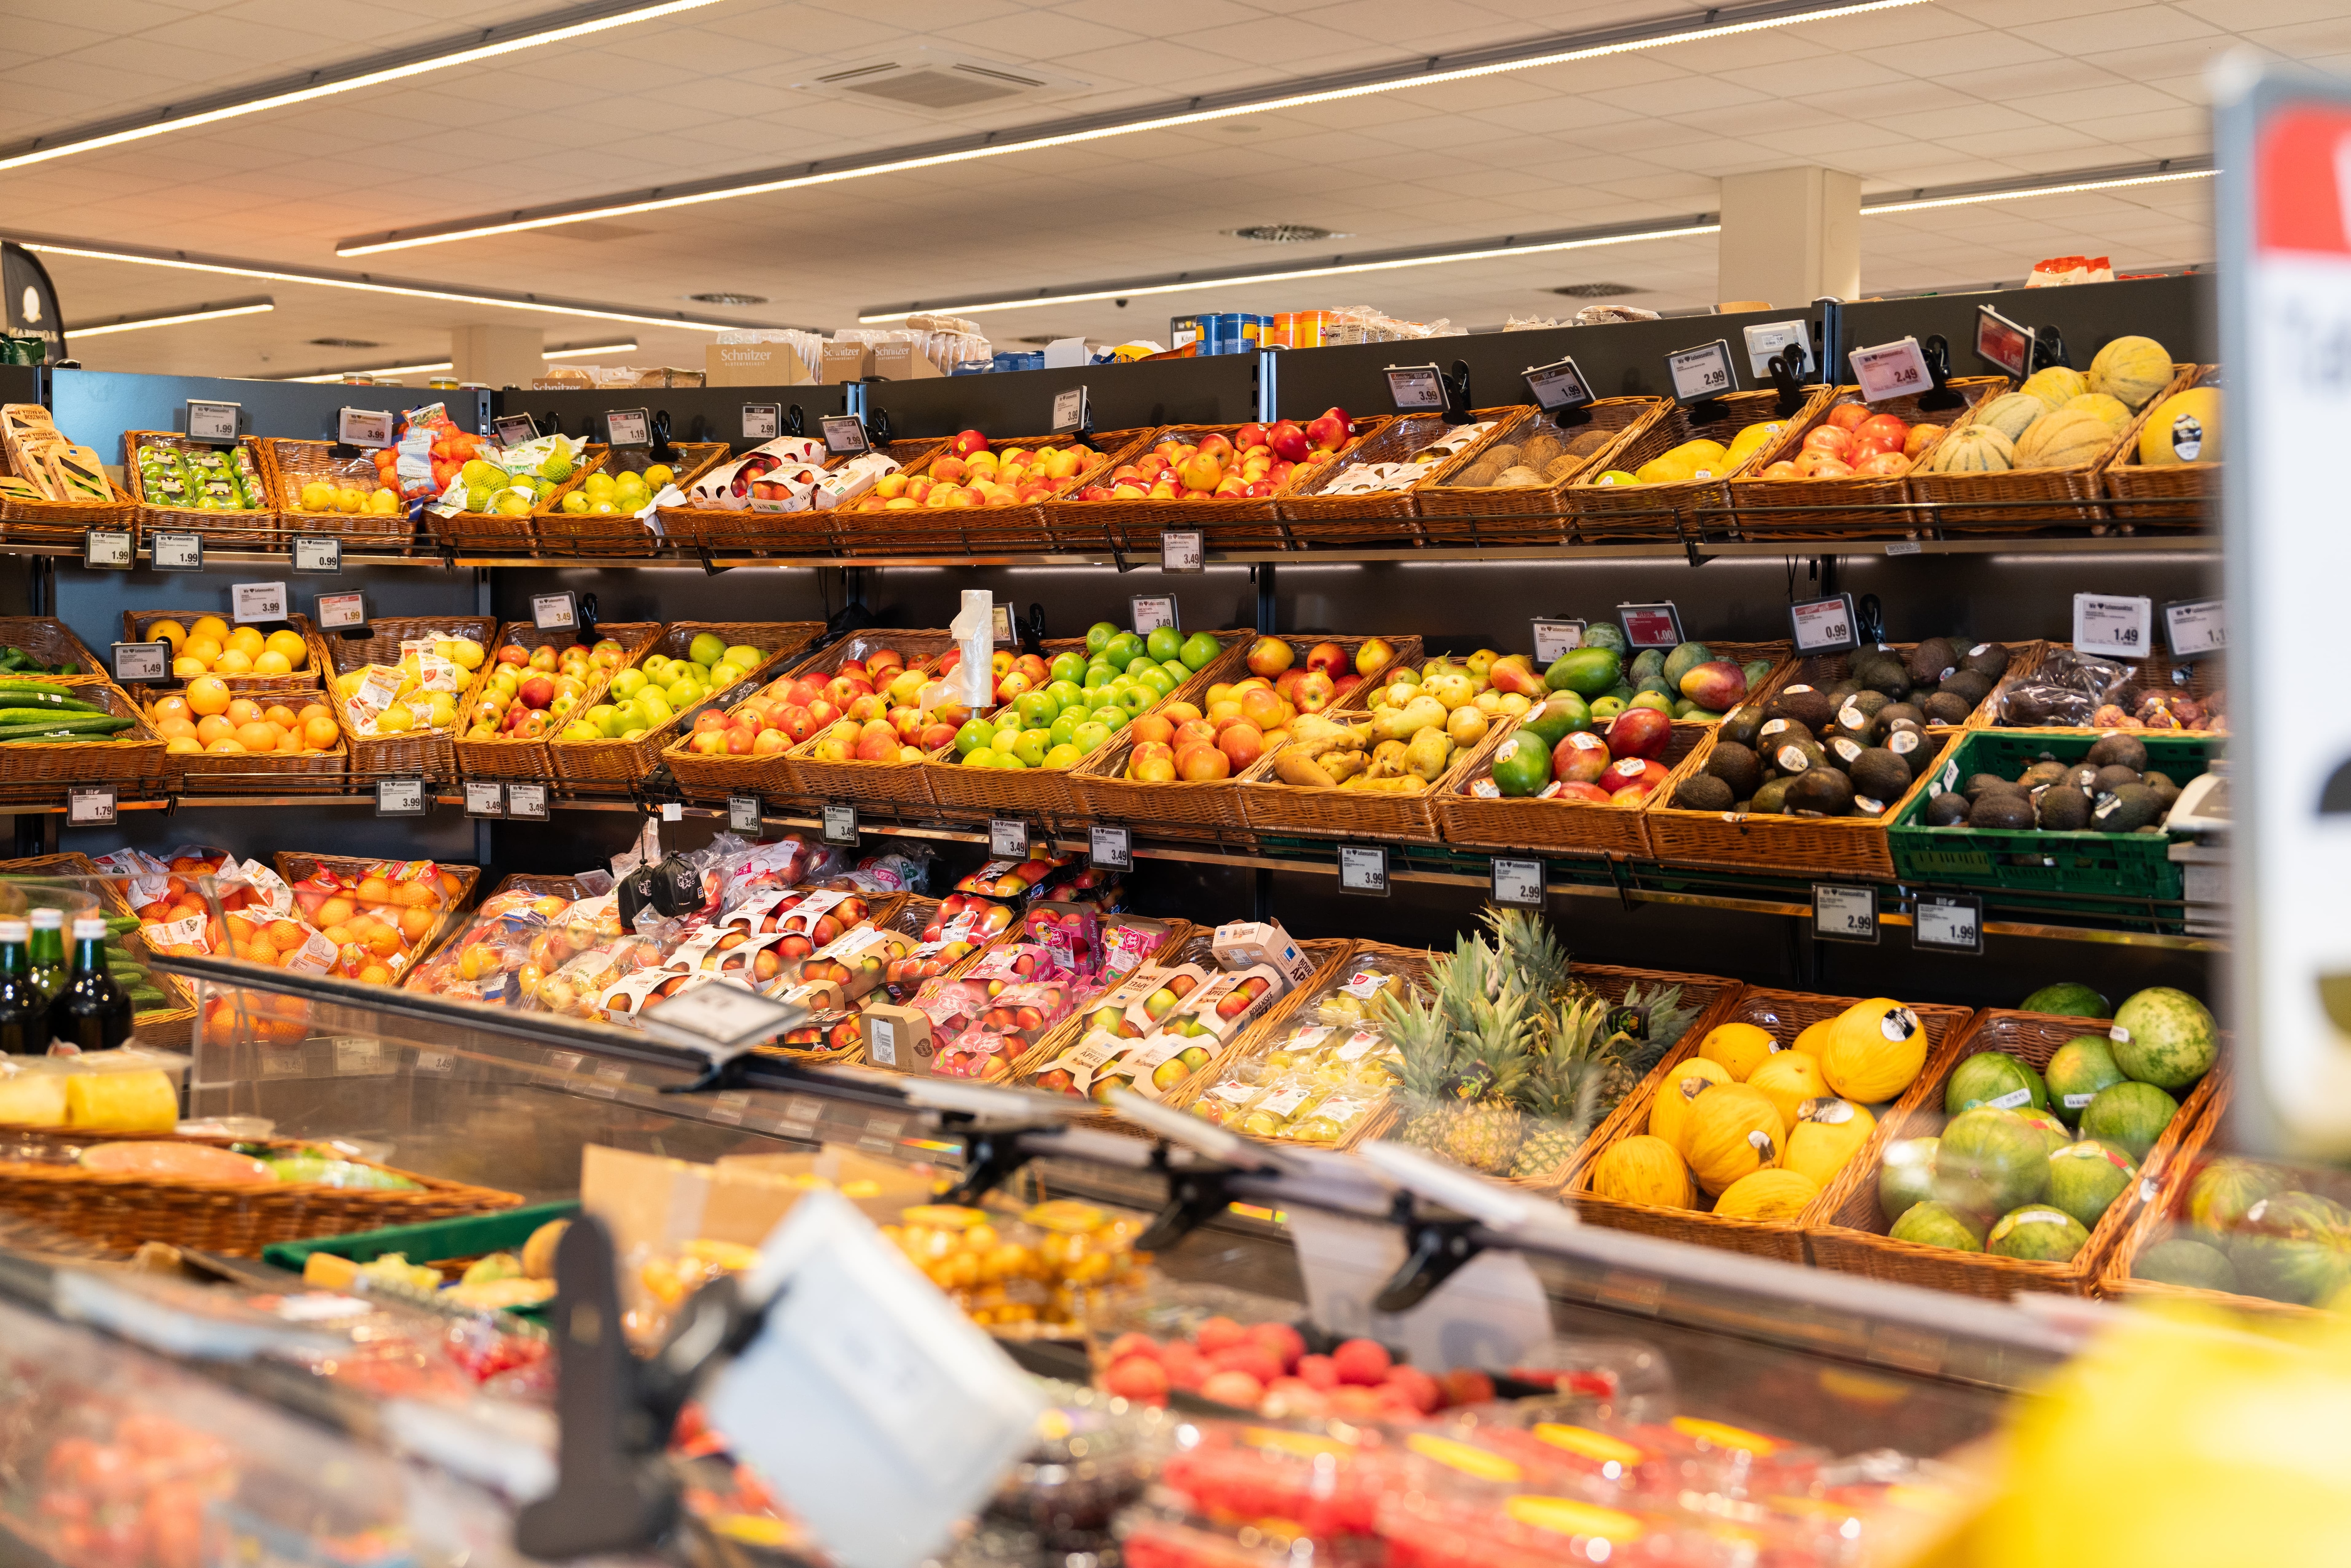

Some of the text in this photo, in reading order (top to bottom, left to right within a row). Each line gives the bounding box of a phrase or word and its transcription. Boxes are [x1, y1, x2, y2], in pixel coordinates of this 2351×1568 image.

[721, 349, 771, 362] Schnitzer
[1704, 370, 1725, 385] 2.99
[1894, 369, 1918, 383] 2.49
[1419, 391, 1438, 401] 3.99
[1561, 385, 1581, 397] 1.99
[1068, 410, 1078, 421] 3.99
[216, 425, 232, 433] 1.99
[761, 425, 774, 433] 2.99
[368, 430, 385, 439] 3.99
[630, 430, 644, 439] 1.19
[112, 551, 128, 559] 1.99
[181, 553, 198, 562] 1.99
[1184, 554, 1199, 564] 3.49
[319, 557, 337, 566] 0.99
[263, 603, 280, 612] 3.99
[344, 611, 360, 620] 1.99
[556, 612, 571, 622] 3.49
[1156, 618, 1171, 628] 3.49
[1654, 630, 1674, 640] 1.00
[1826, 624, 1847, 638] 0.99
[2114, 628, 2138, 641] 1.49
[143, 664, 161, 672] 1.49
[403, 798, 420, 807] 3.99
[486, 801, 500, 810] 3.49
[529, 803, 544, 812] 3.49
[95, 806, 112, 816] 1.79
[745, 817, 757, 827] 3.49
[841, 826, 854, 836] 3.49
[1010, 841, 1025, 852] 3.49
[1111, 849, 1127, 860] 3.49
[874, 869, 897, 886] ÄPFEL
[1365, 872, 1383, 884] 3.99
[1521, 885, 1540, 898] 2.99
[1847, 915, 1870, 930] 2.99
[1949, 925, 1974, 939] 1.99
[305, 954, 329, 968] ORANGEN
[1290, 964, 1308, 982] ÄP
[1249, 991, 1274, 1016] BODENSEE
[1049, 1003, 1071, 1029] Pink Lady
[921, 1041, 932, 1055] Pink
[1080, 1049, 1103, 1064] ÄPFEL
[1086, 1047, 1109, 1060] BODENSEE
